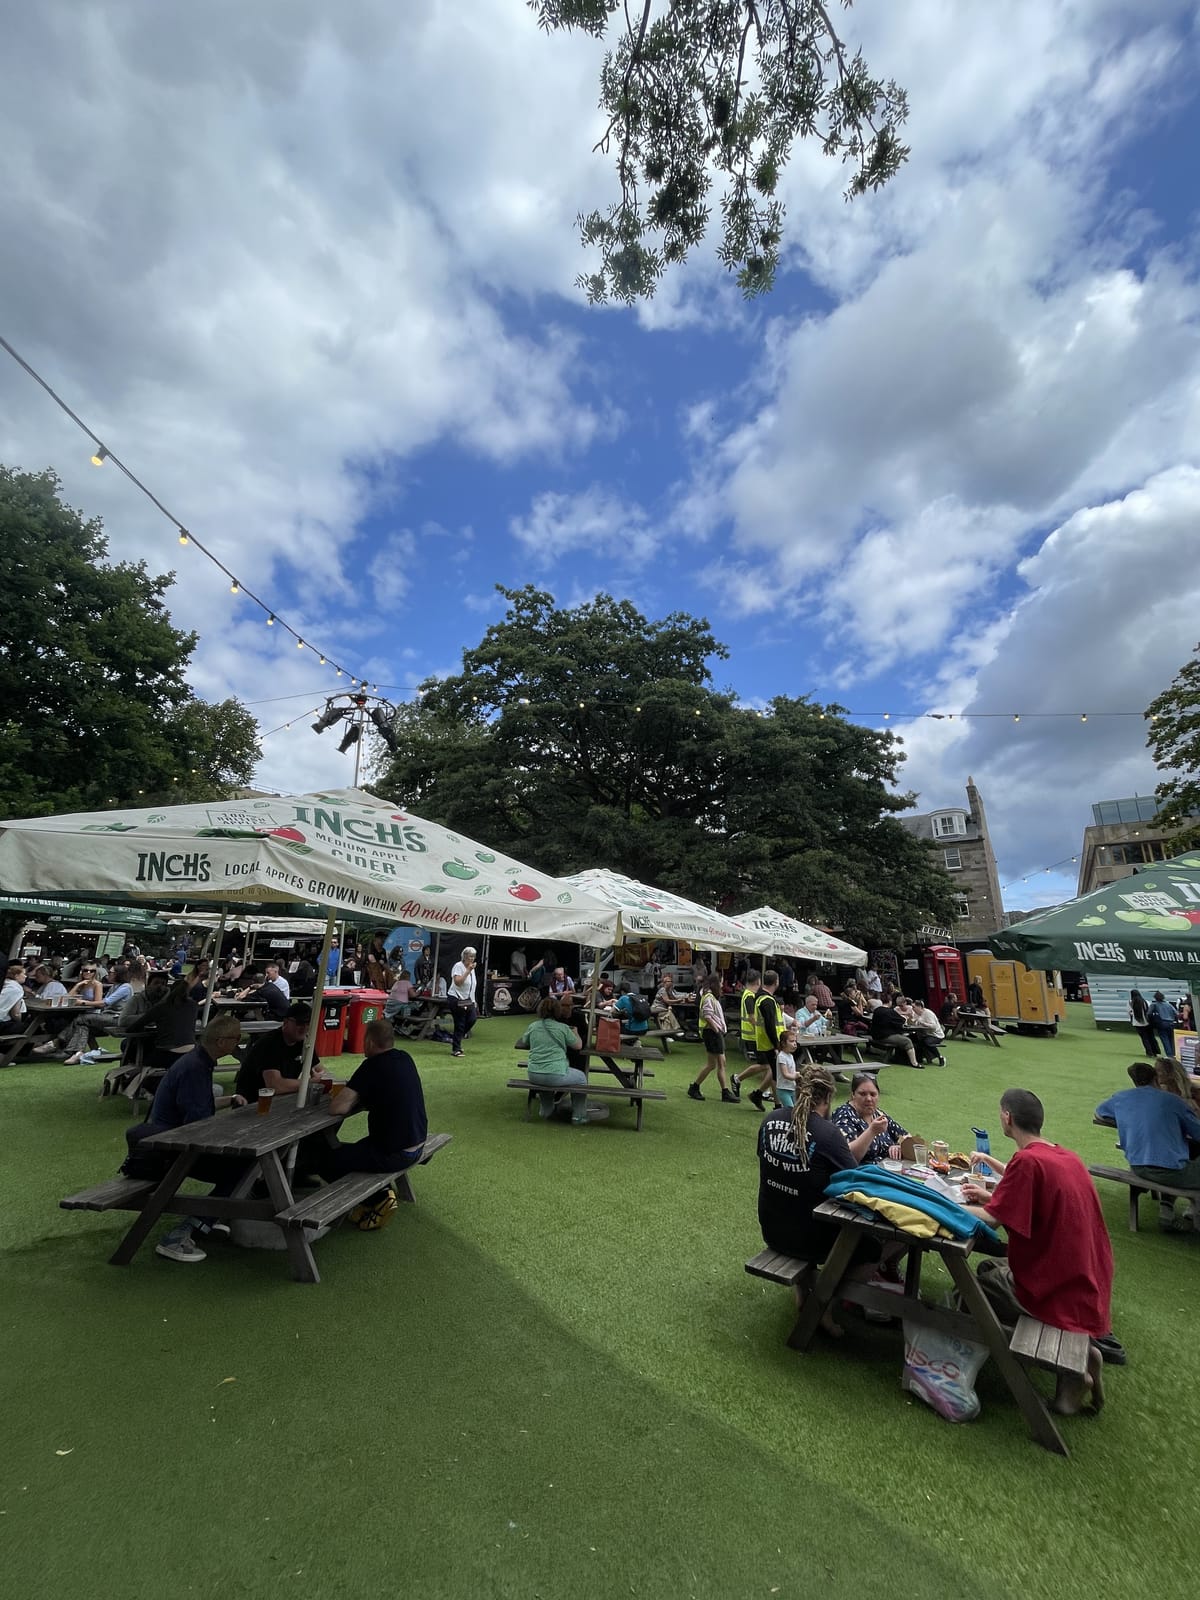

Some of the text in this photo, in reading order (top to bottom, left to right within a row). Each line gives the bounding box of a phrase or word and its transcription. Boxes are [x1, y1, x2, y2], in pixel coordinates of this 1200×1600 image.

[292, 806, 427, 853] INCH'S
[315, 832, 409, 862] MEDIUM APPLE
[135, 851, 529, 933] INCH'S LOCAL APPLES GROWN WITHIN 40 miles OF OUR MILL
[1073, 941, 1126, 963] INCH'S
[1133, 949, 1152, 960] WE
[1152, 949, 1184, 962] TURN
[763, 1149, 811, 1173] YOU WILL
[766, 1179, 799, 1197] CONIFER
